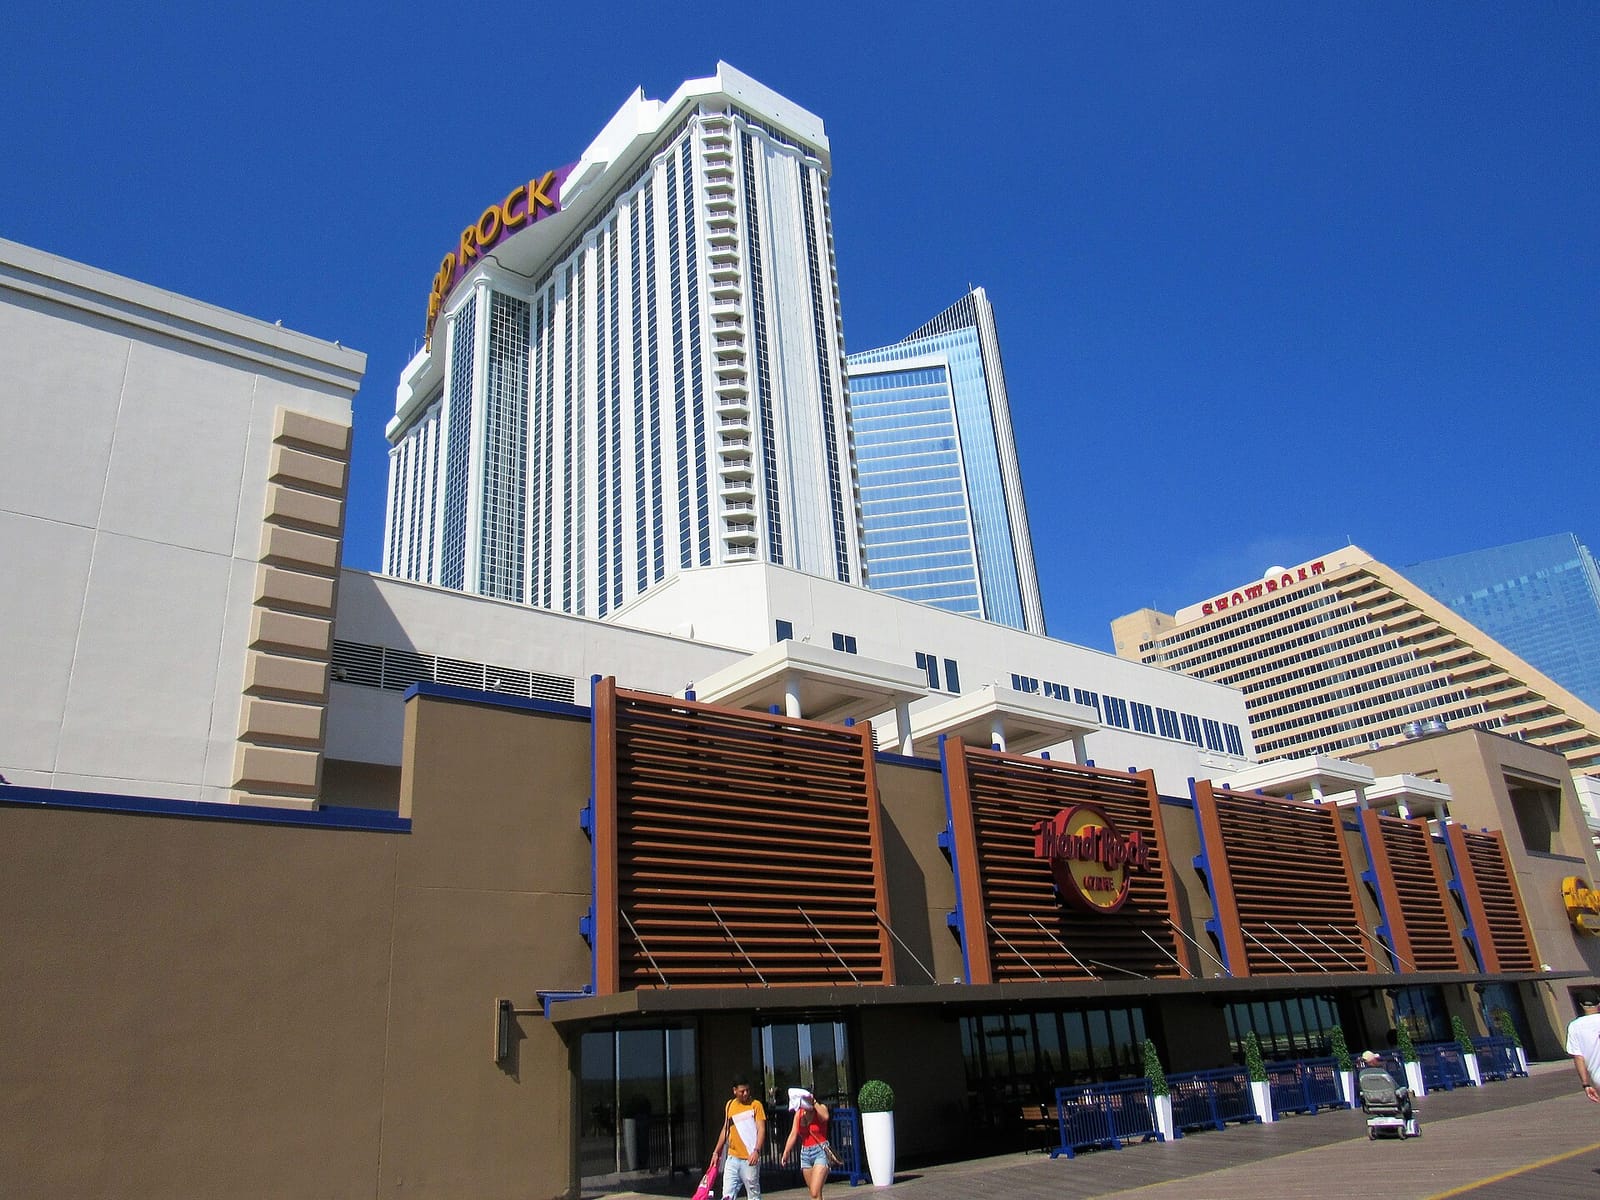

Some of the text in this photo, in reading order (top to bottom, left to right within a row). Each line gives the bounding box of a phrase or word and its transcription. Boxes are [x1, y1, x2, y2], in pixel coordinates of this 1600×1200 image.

[460, 170, 554, 266] ROCK
[1201, 561, 1326, 616] SHOWBOAT
[1032, 820, 1150, 872] Hard Rock
